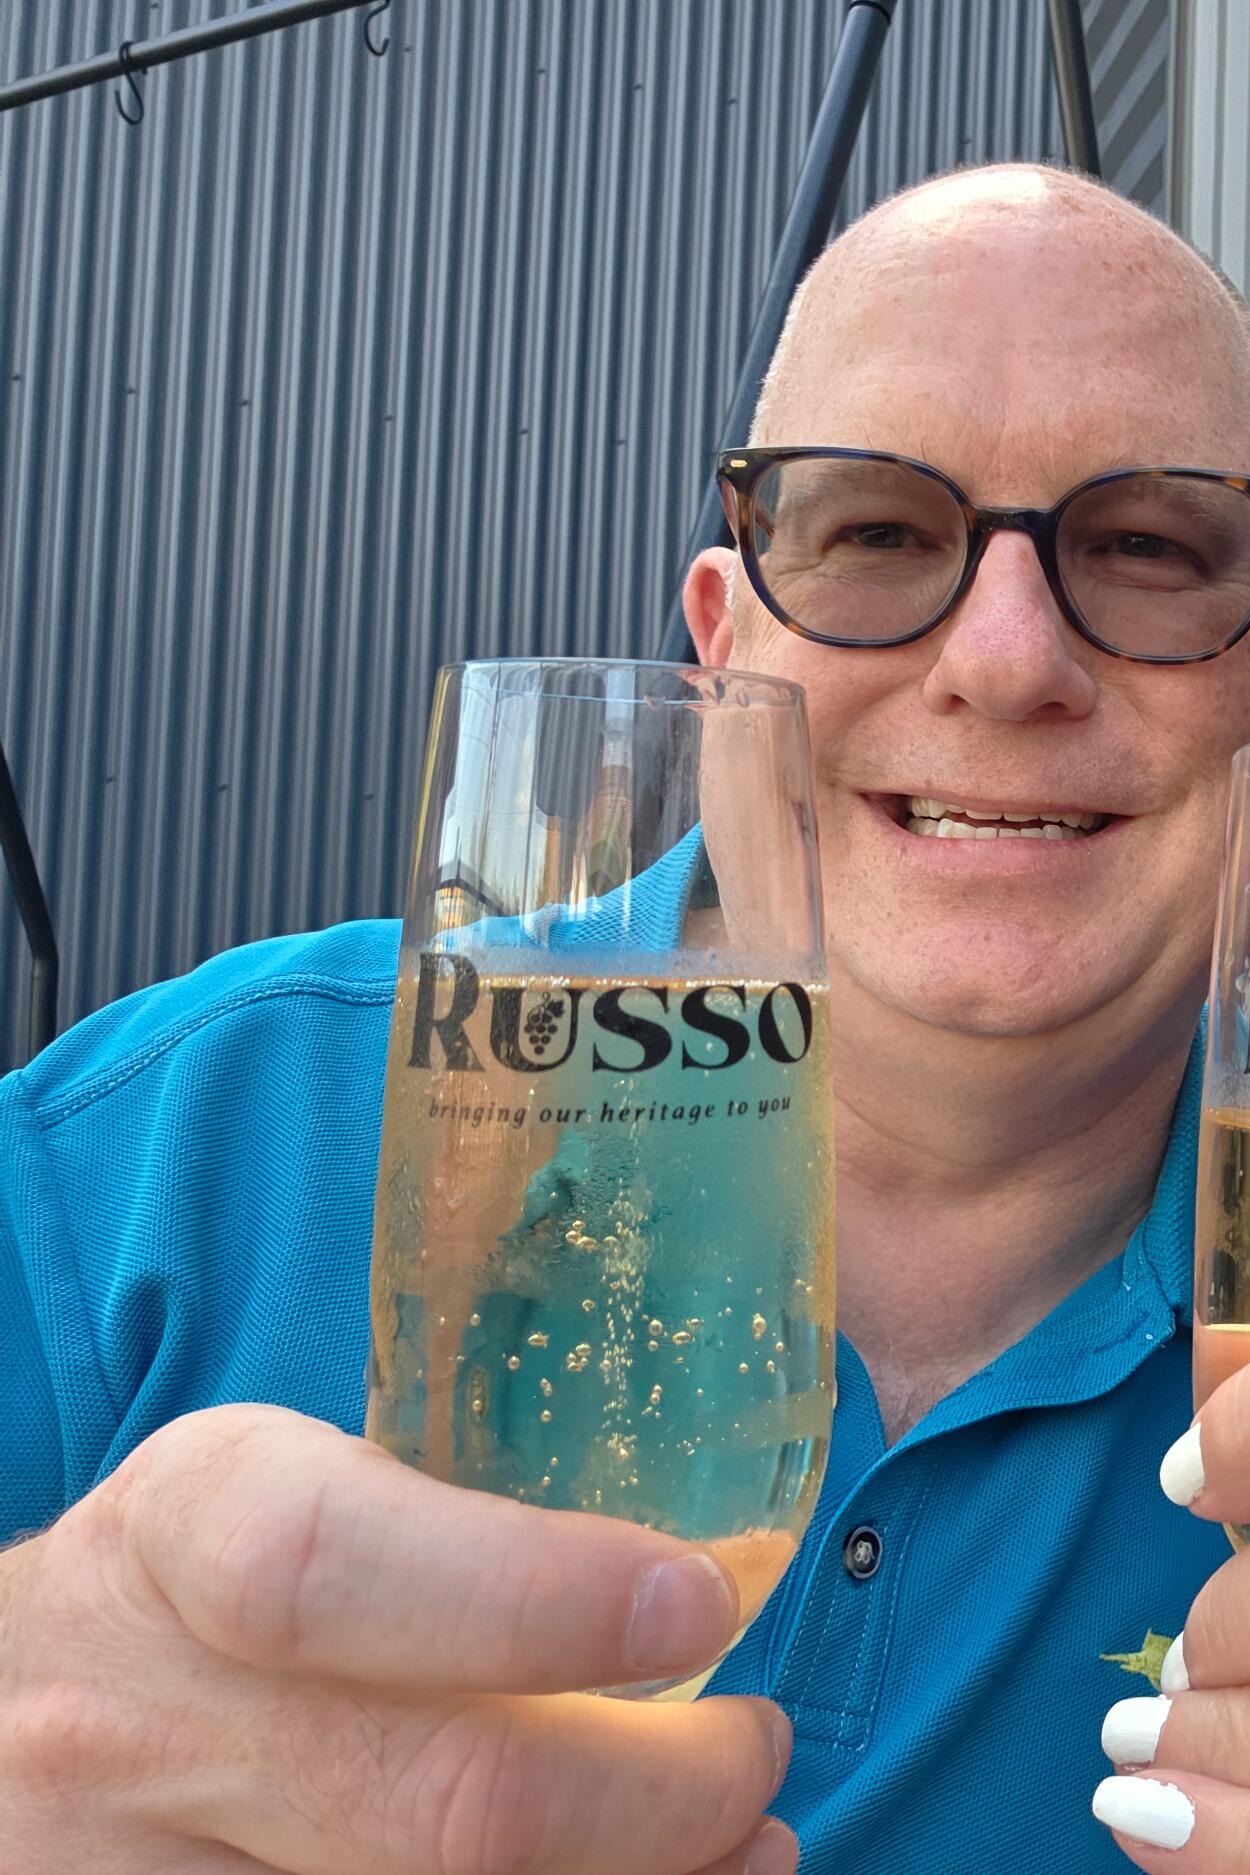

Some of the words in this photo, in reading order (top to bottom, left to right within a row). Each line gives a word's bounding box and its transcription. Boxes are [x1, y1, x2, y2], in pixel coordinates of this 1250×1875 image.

[407, 952, 813, 1072] RUSSO
[429, 1098, 526, 1129] bringing
[539, 1108, 585, 1123] our
[600, 1102, 714, 1128] heritage
[727, 1101, 748, 1116] to
[758, 1096, 791, 1121] you
